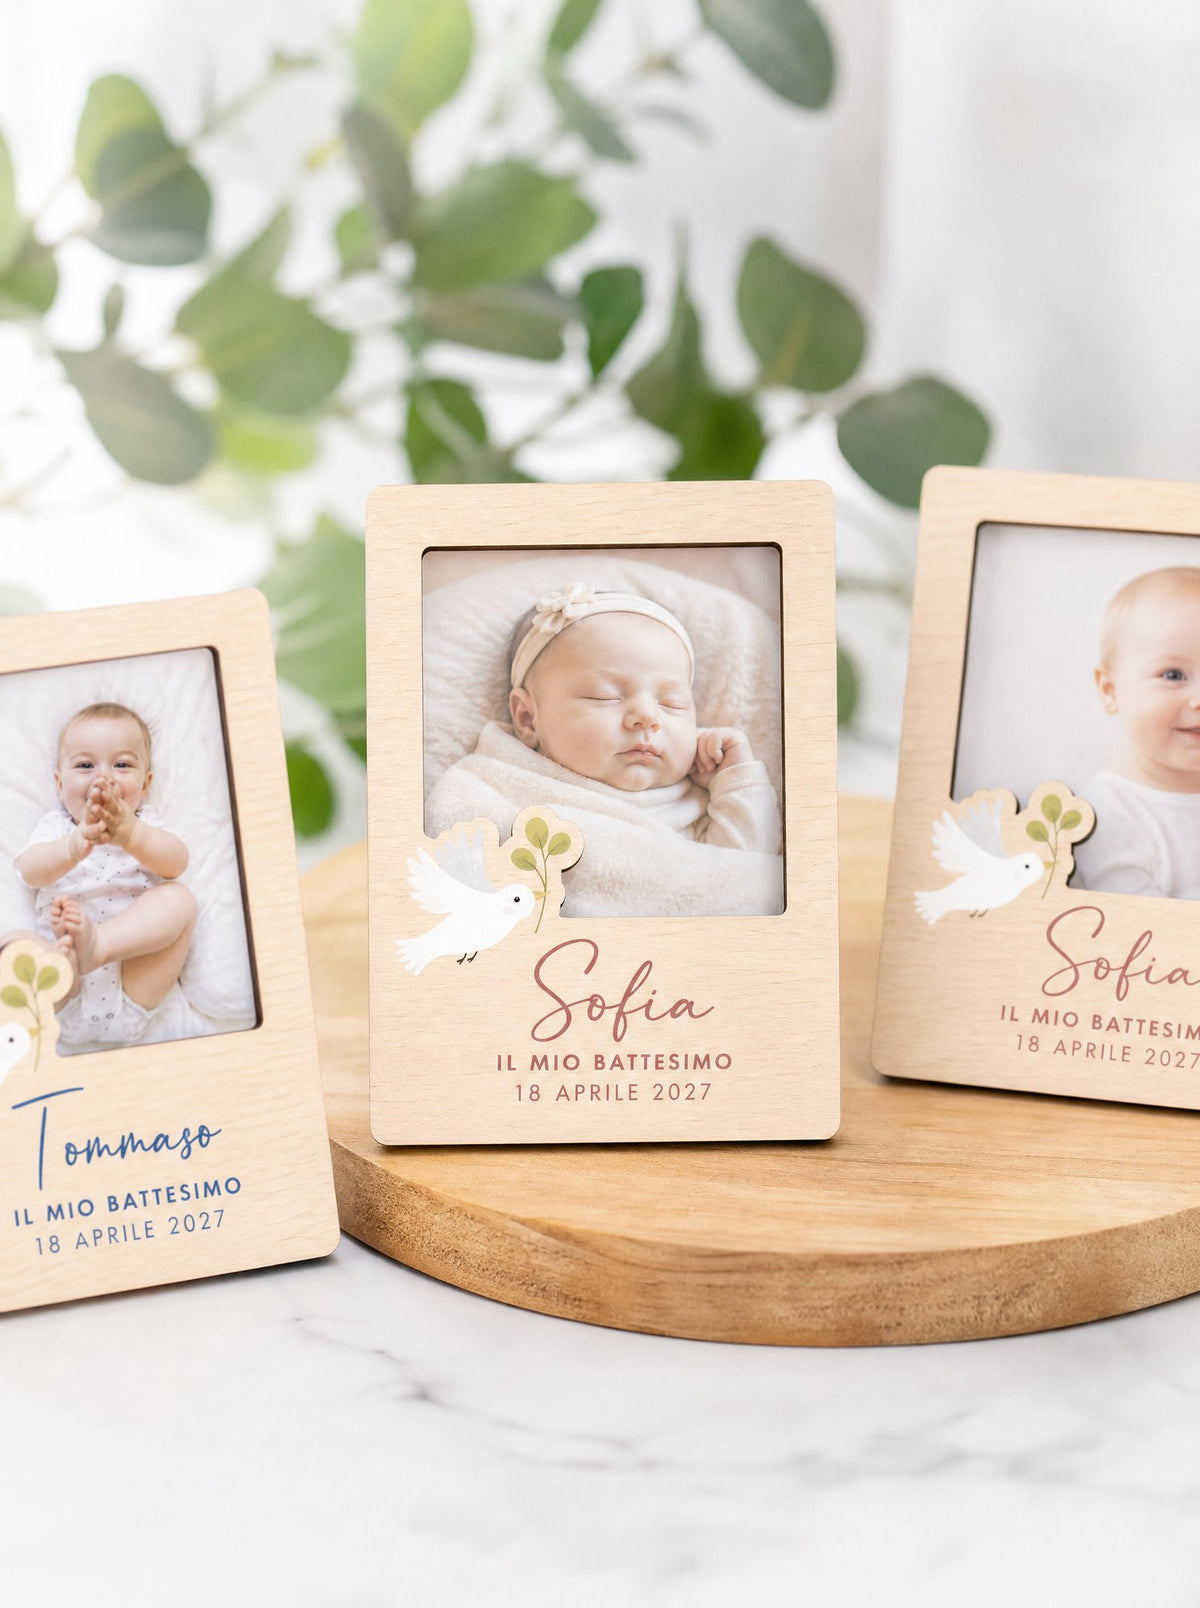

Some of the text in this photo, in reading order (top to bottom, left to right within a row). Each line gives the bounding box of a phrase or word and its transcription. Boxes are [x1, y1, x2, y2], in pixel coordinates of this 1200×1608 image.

[1041, 905, 1200, 1001] Sofia
[531, 938, 715, 1042] Sofia
[1000, 1004, 1019, 1022] IL
[1031, 1008, 1079, 1028] MIO
[497, 1053, 732, 1071] IL MIO BATTESIMO
[1016, 1034, 1200, 1070] 18 APRILE 2027
[515, 1082, 712, 1101] 18 APRILE 2027
[12, 1087, 222, 1191] Tommaso
[14, 1177, 241, 1227] IL MIO BATTESIMO
[35, 1209, 225, 1255] 18 APRILE 2027
